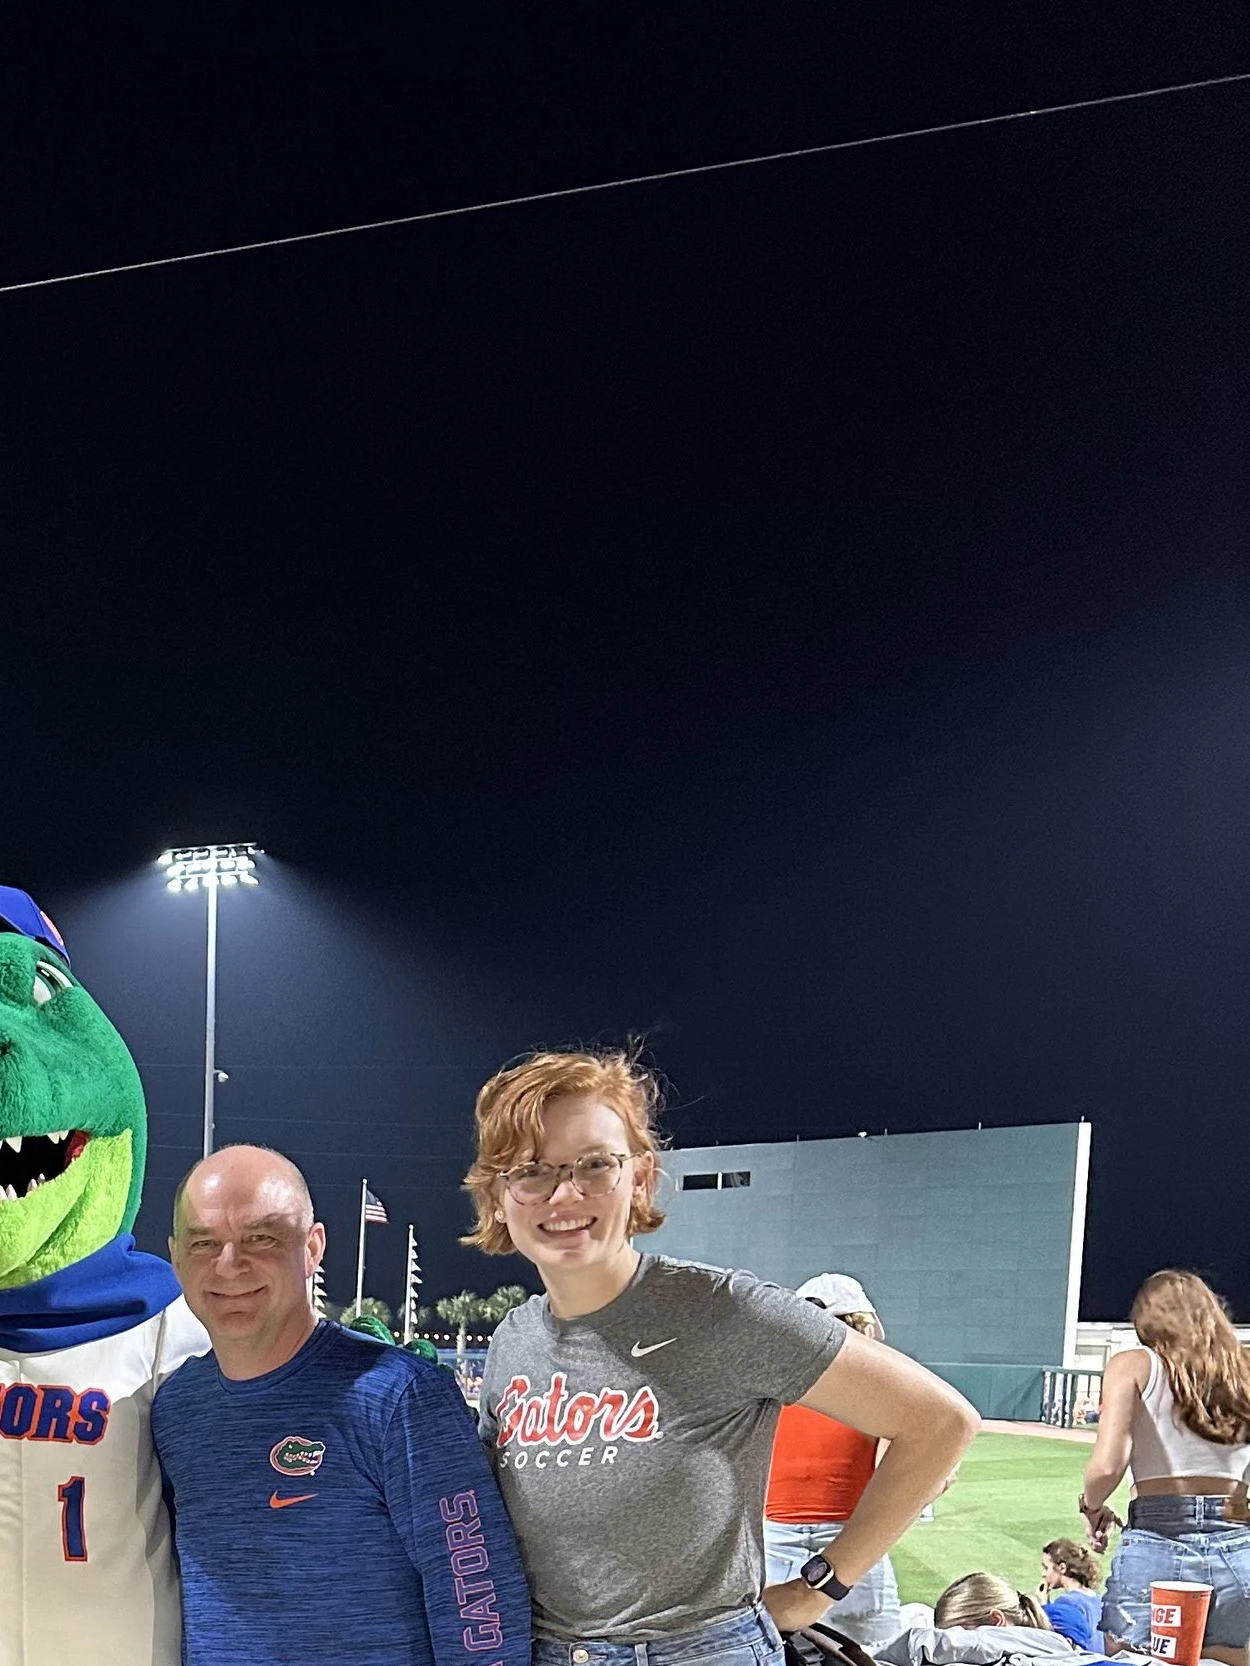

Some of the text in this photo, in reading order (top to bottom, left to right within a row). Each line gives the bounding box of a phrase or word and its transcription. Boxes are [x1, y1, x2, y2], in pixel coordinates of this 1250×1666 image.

[496, 1372, 659, 1449] Gators
[500, 1446, 618, 1469] SOCCER
[57, 1476, 88, 1562] 1
[439, 1490, 504, 1652] GATORS
